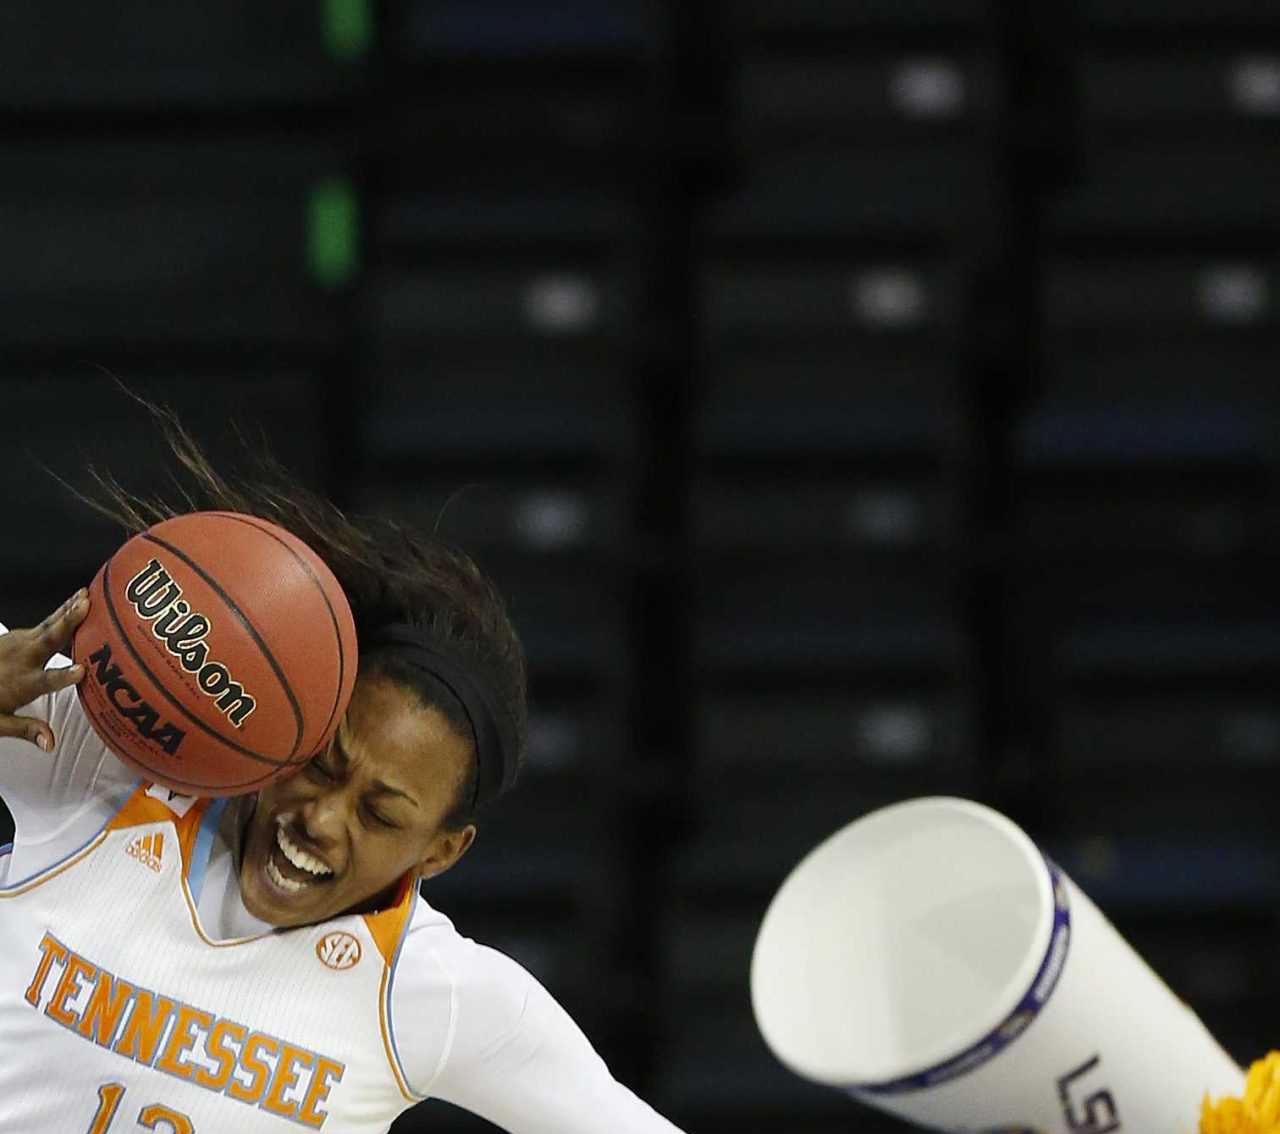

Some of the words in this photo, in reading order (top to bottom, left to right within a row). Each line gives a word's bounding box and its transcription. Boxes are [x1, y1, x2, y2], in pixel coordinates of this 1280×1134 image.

[89, 641, 186, 757] NCAA
[125, 558, 256, 728] Wilson
[23, 930, 346, 1131] TENNESSEE
